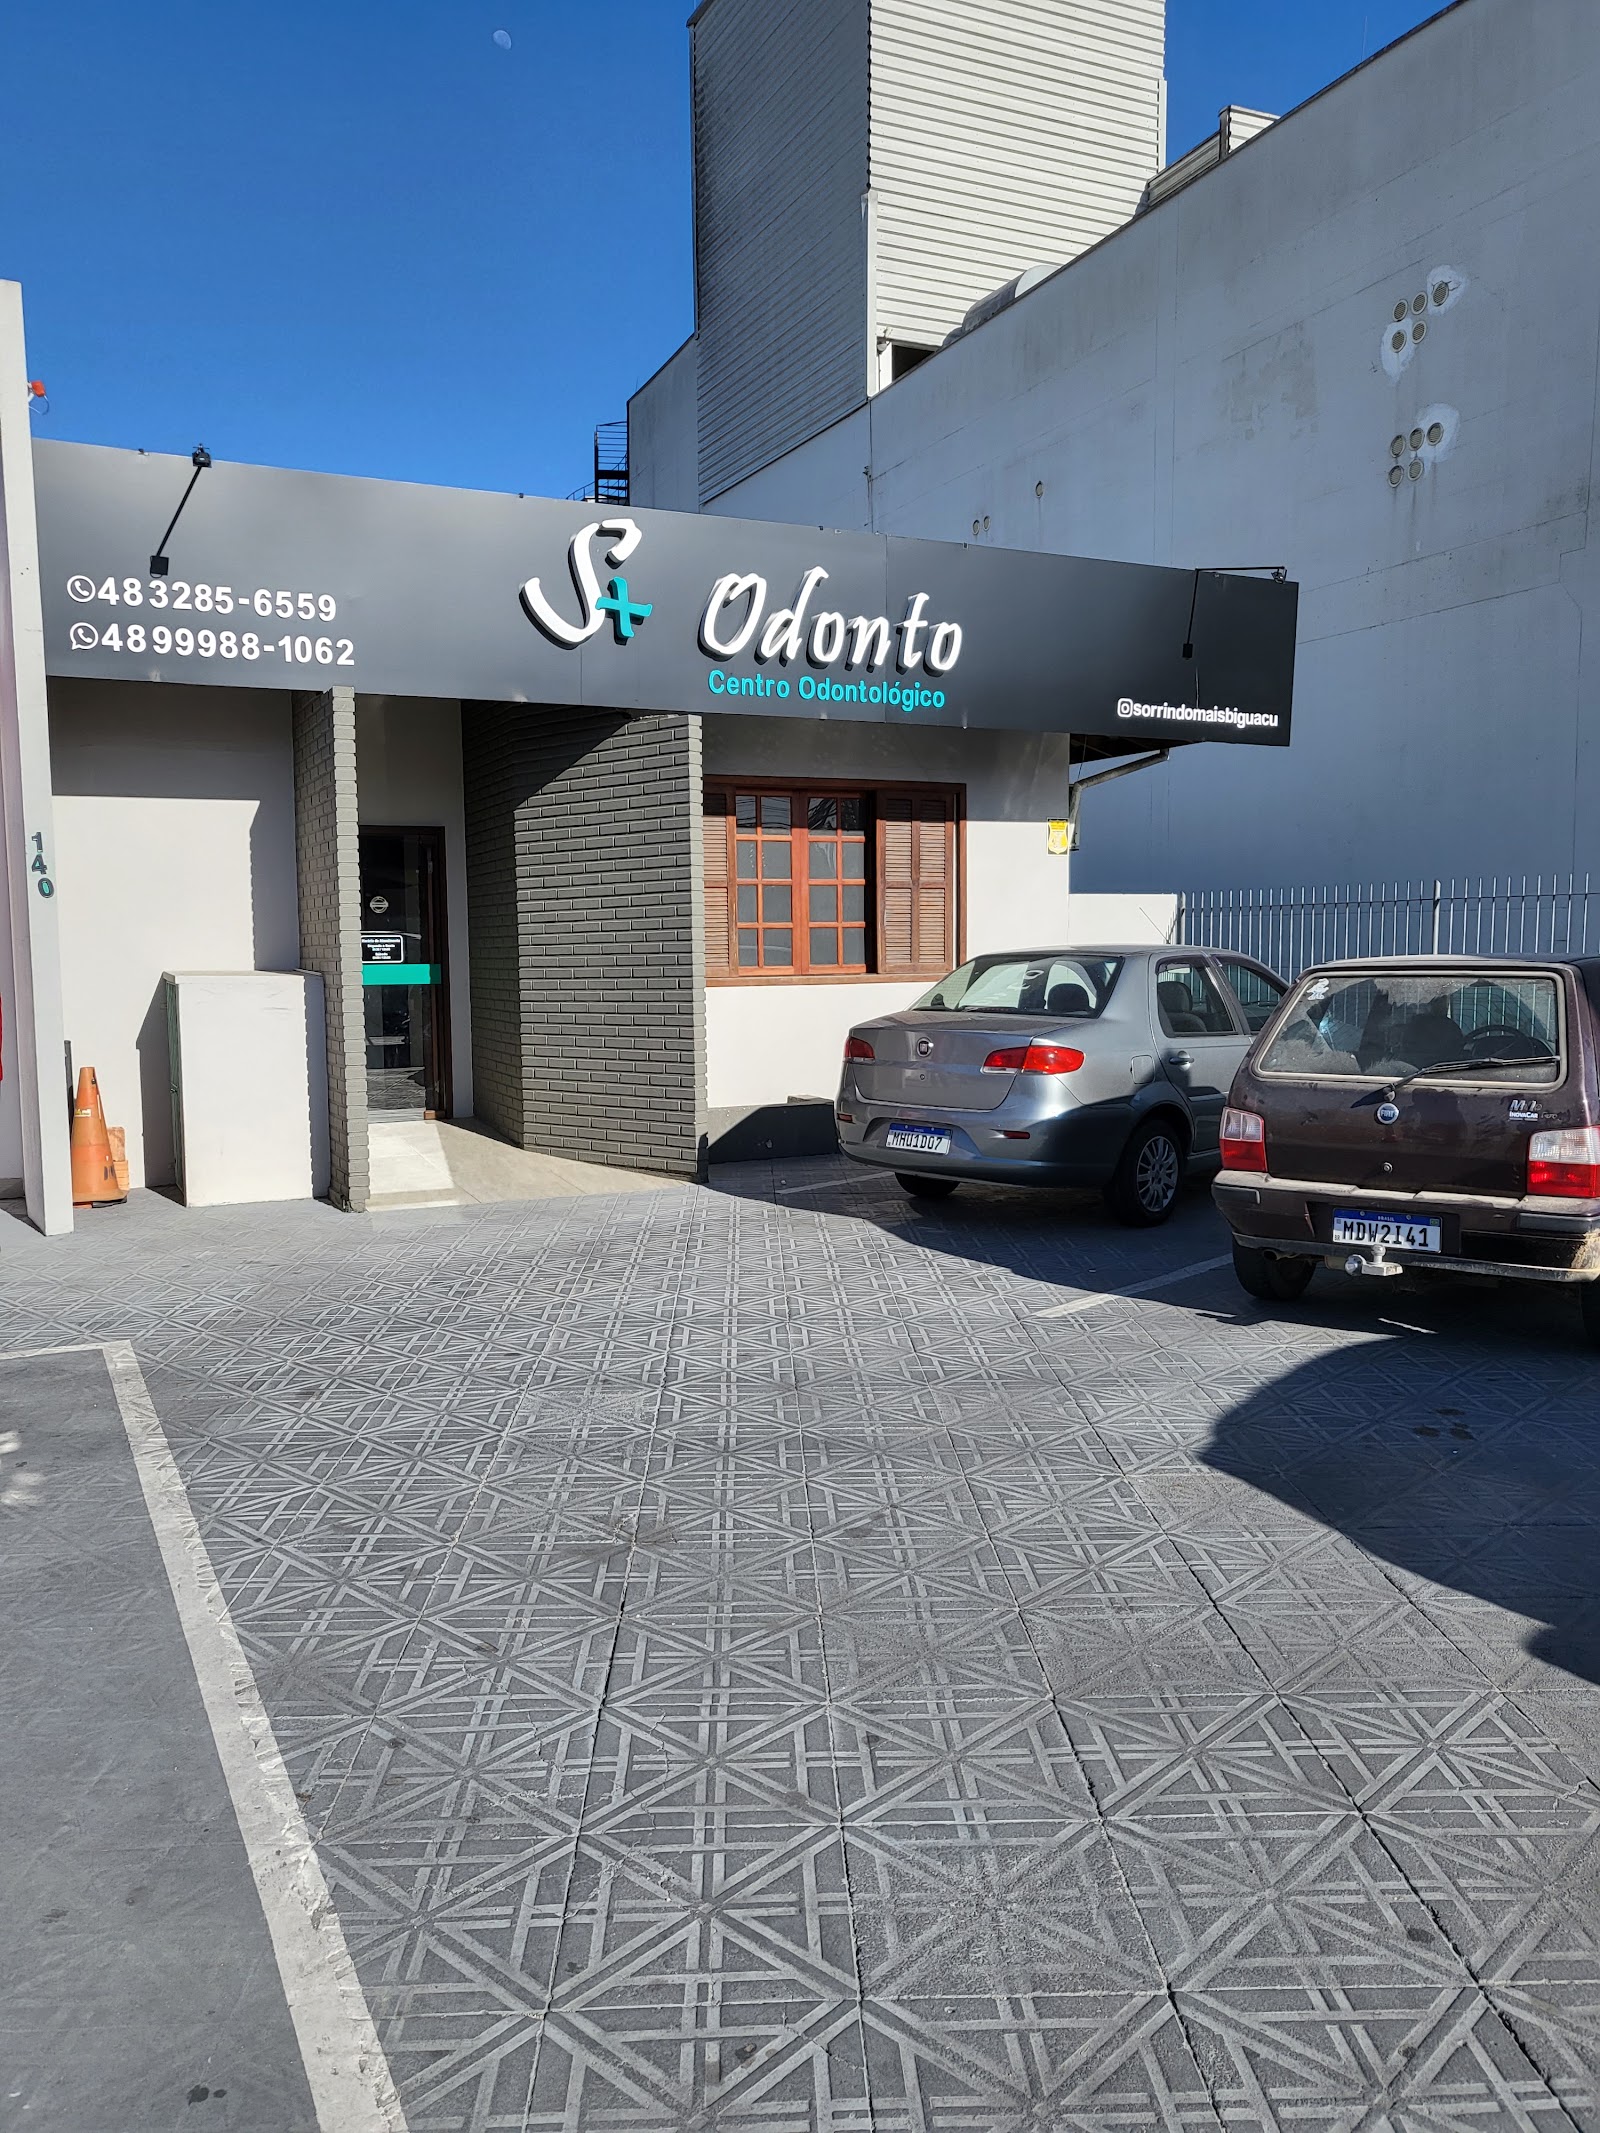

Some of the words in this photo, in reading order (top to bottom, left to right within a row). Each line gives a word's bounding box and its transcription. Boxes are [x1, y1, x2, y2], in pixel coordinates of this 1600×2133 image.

[699, 565, 963, 673] Odonto
[708, 669, 790, 698] Centro
[798, 675, 946, 713] Odontológico
[31, 831, 55, 899] 140
[892, 1131, 943, 1151] MHU1D07
[1343, 1220, 1429, 1248] MDW2I41
